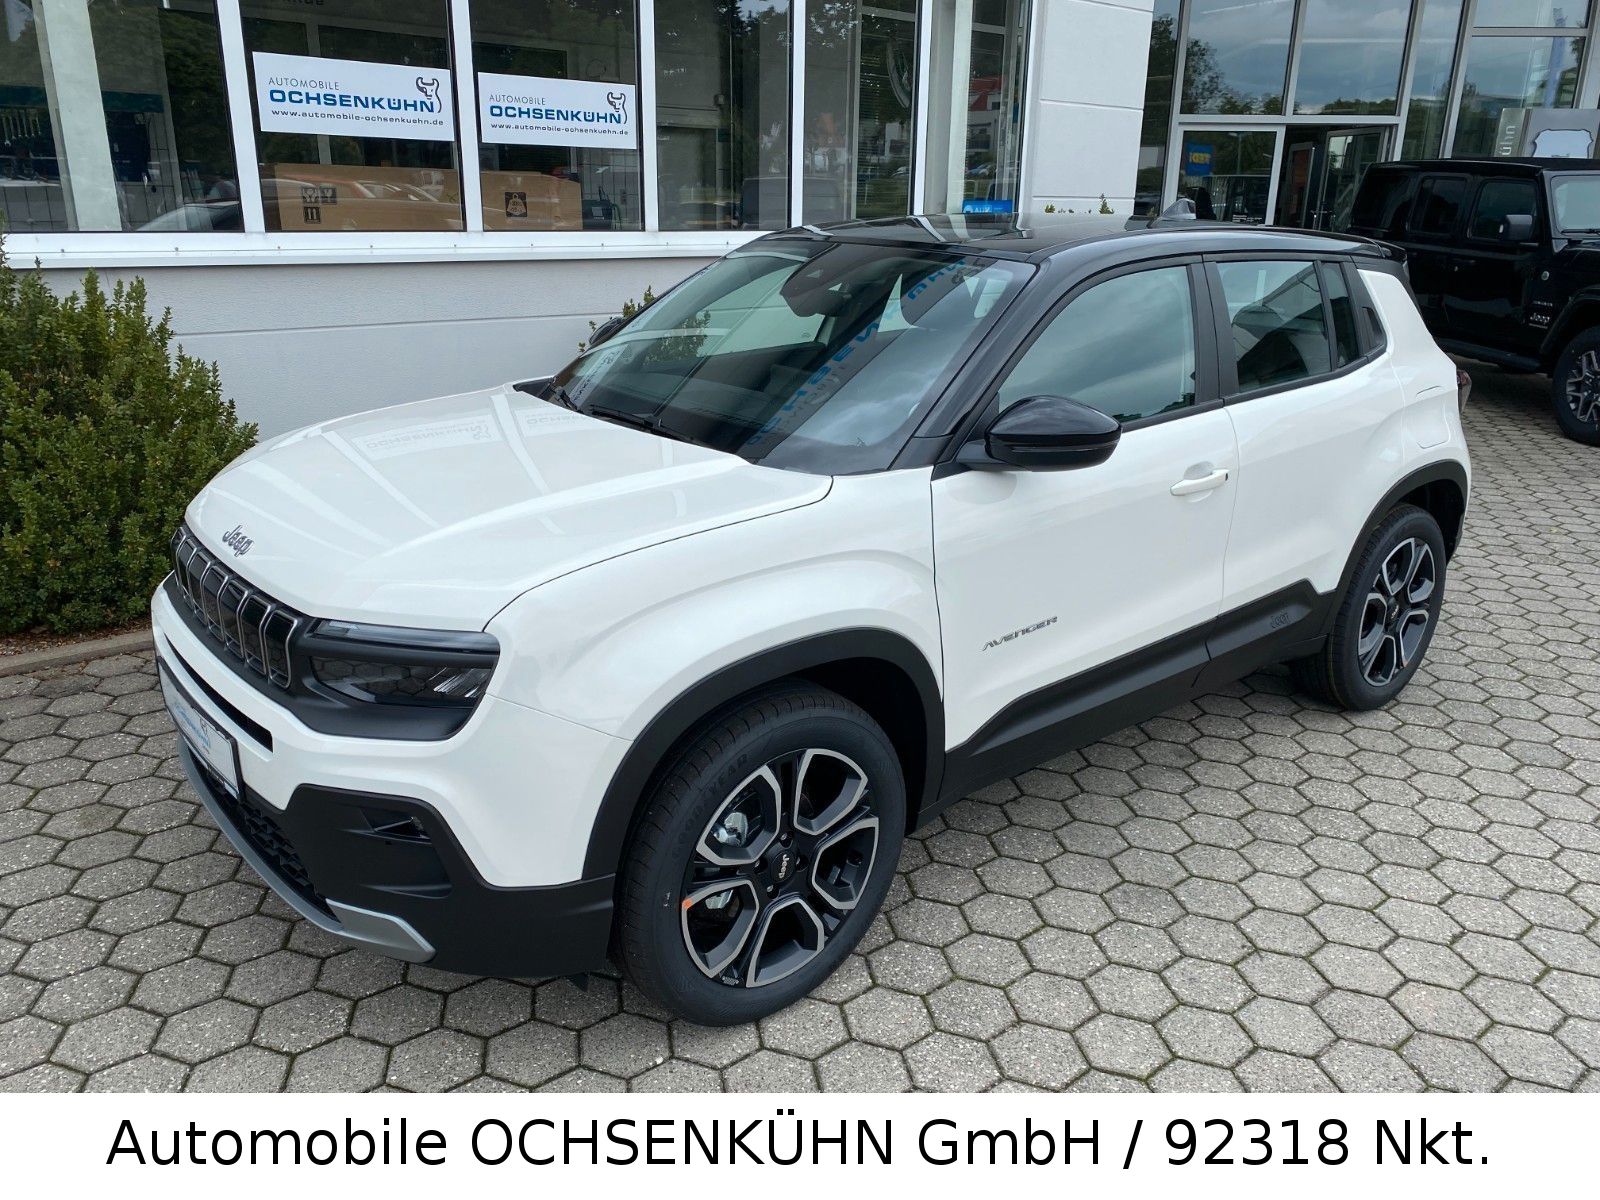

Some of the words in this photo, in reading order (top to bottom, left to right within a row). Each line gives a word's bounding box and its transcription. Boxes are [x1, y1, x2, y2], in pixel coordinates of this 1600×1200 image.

[268, 77, 340, 91] AUTOMOBILE
[269, 89, 435, 113] OCHSENKÜHN
[489, 94, 546, 106] AUTOMOBILE
[271, 109, 444, 126] www.automobile-ochsenkuehn.de
[490, 105, 622, 124] OCHSENKÜHN
[491, 123, 629, 135] www.automobile-ochsenkuehn.de
[222, 524, 254, 558] Jeep
[981, 615, 1058, 652] AVENGER
[778, 853, 790, 879] Jeep
